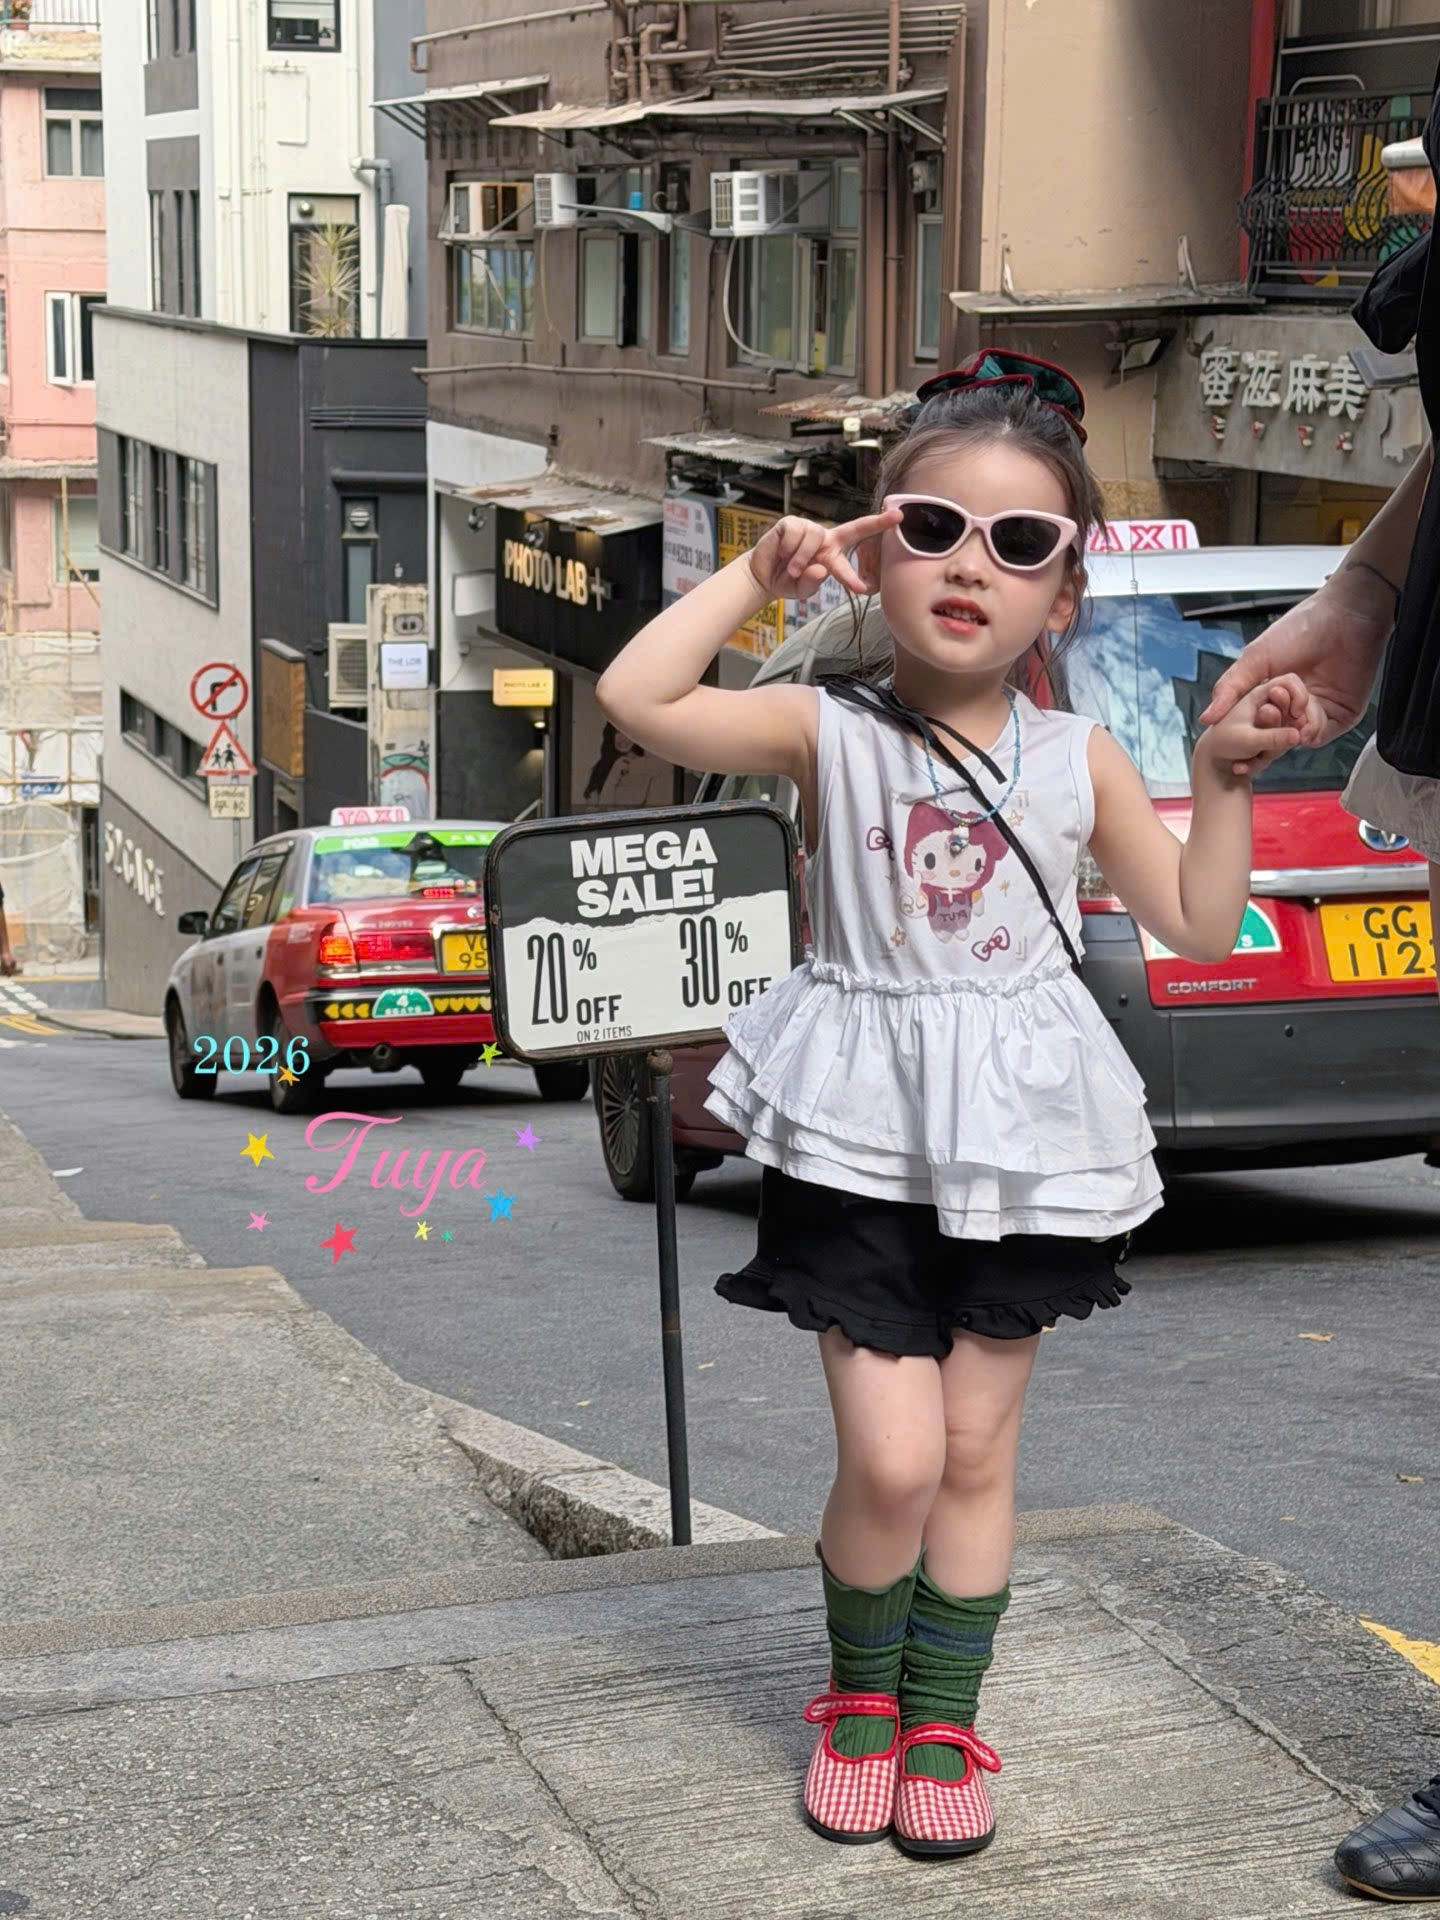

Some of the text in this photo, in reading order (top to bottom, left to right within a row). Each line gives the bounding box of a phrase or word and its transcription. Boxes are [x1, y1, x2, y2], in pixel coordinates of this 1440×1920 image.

[1089, 523, 1188, 552] AXI
[504, 539, 553, 593] PHOTO
[554, 555, 588, 605] LAB
[338, 809, 405, 825] TAXI
[570, 827, 719, 879] MEGA
[576, 867, 715, 919] SALE!
[1363, 905, 1418, 940] GG
[1348, 940, 1437, 977] 112
[728, 976, 772, 1007] OFF
[1167, 977, 1257, 995] COMFORT
[576, 994, 623, 1025] OFF
[576, 1025, 633, 1043] ON 2 ITEMS
